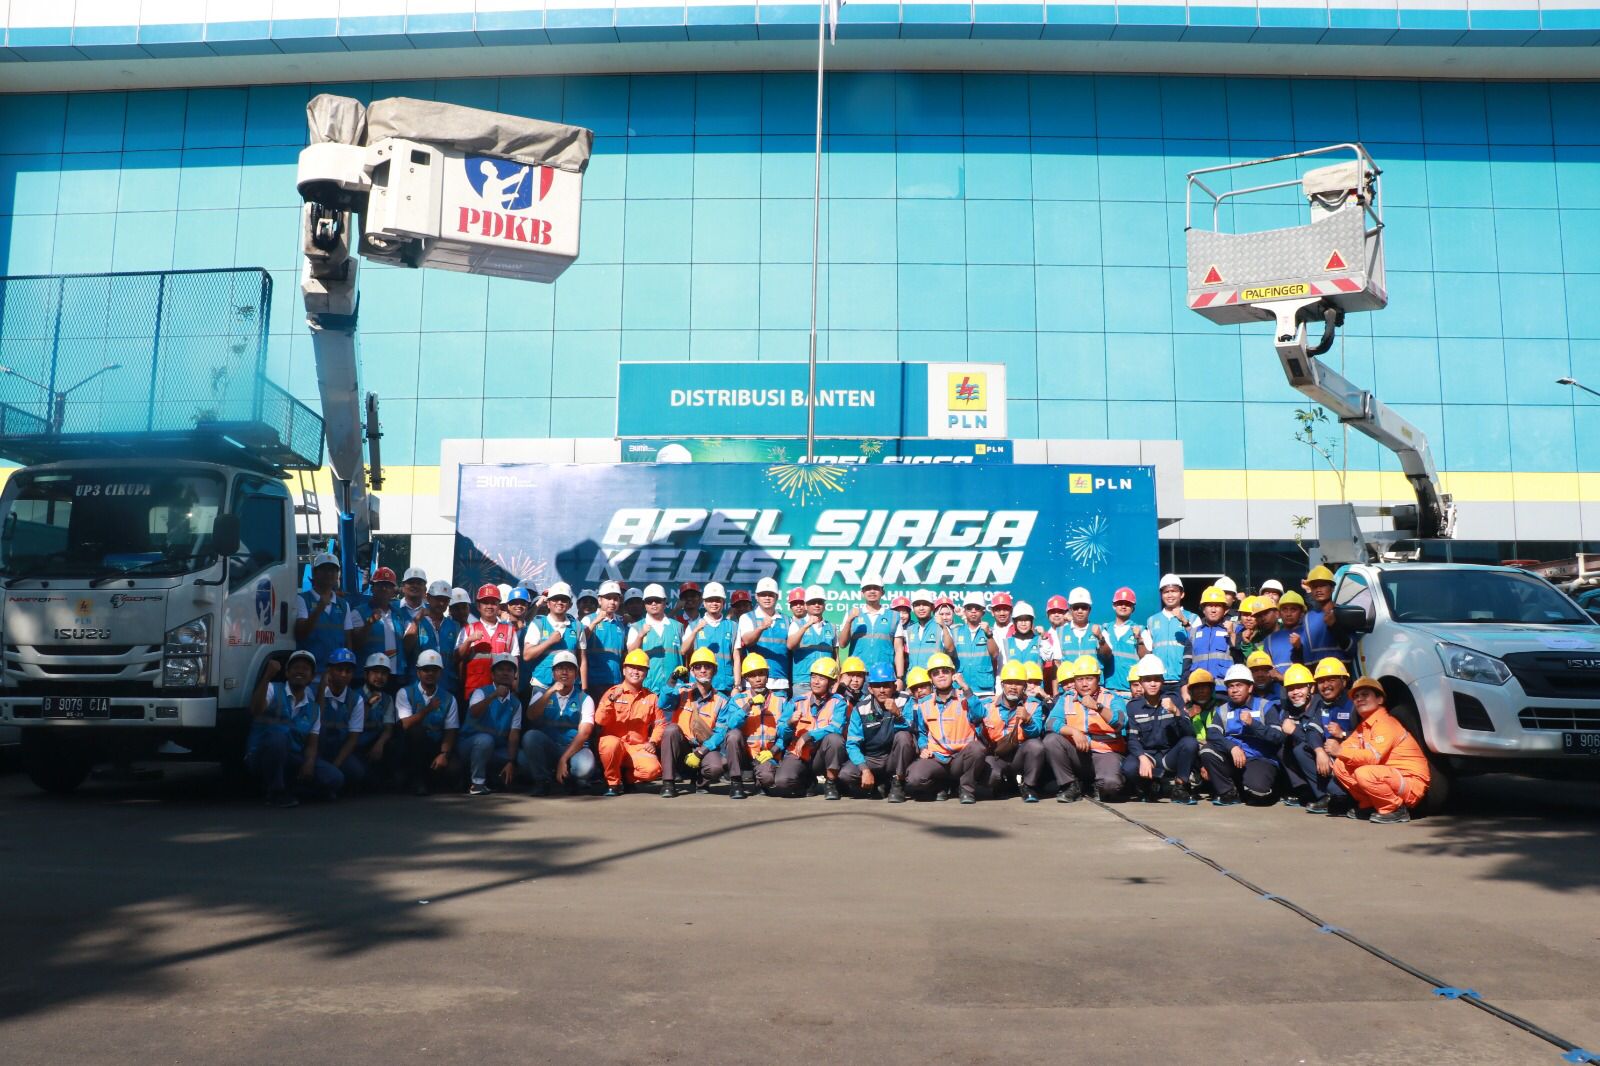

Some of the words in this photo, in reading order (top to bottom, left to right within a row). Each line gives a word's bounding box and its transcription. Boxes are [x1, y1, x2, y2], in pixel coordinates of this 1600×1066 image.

[457, 206, 553, 246] PDKB
[1245, 284, 1305, 300] PALFINGER
[670, 389, 785, 407] DISTRIBUSI
[948, 415, 987, 429] PLN
[76, 485, 101, 497] UP3
[104, 484, 152, 496] CIKUPA
[1095, 478, 1132, 490] PLN
[602, 508, 791, 546] APEL
[808, 509, 1039, 547] SIAGA
[585, 549, 1024, 585] KELISTRIKAN
[827, 590, 862, 601] DAN
[54, 628, 111, 640] ISUZU
[45, 698, 52, 711] B
[59, 698, 83, 711] 9079
[89, 698, 108, 711] CIA
[1565, 734, 1572, 747] B
